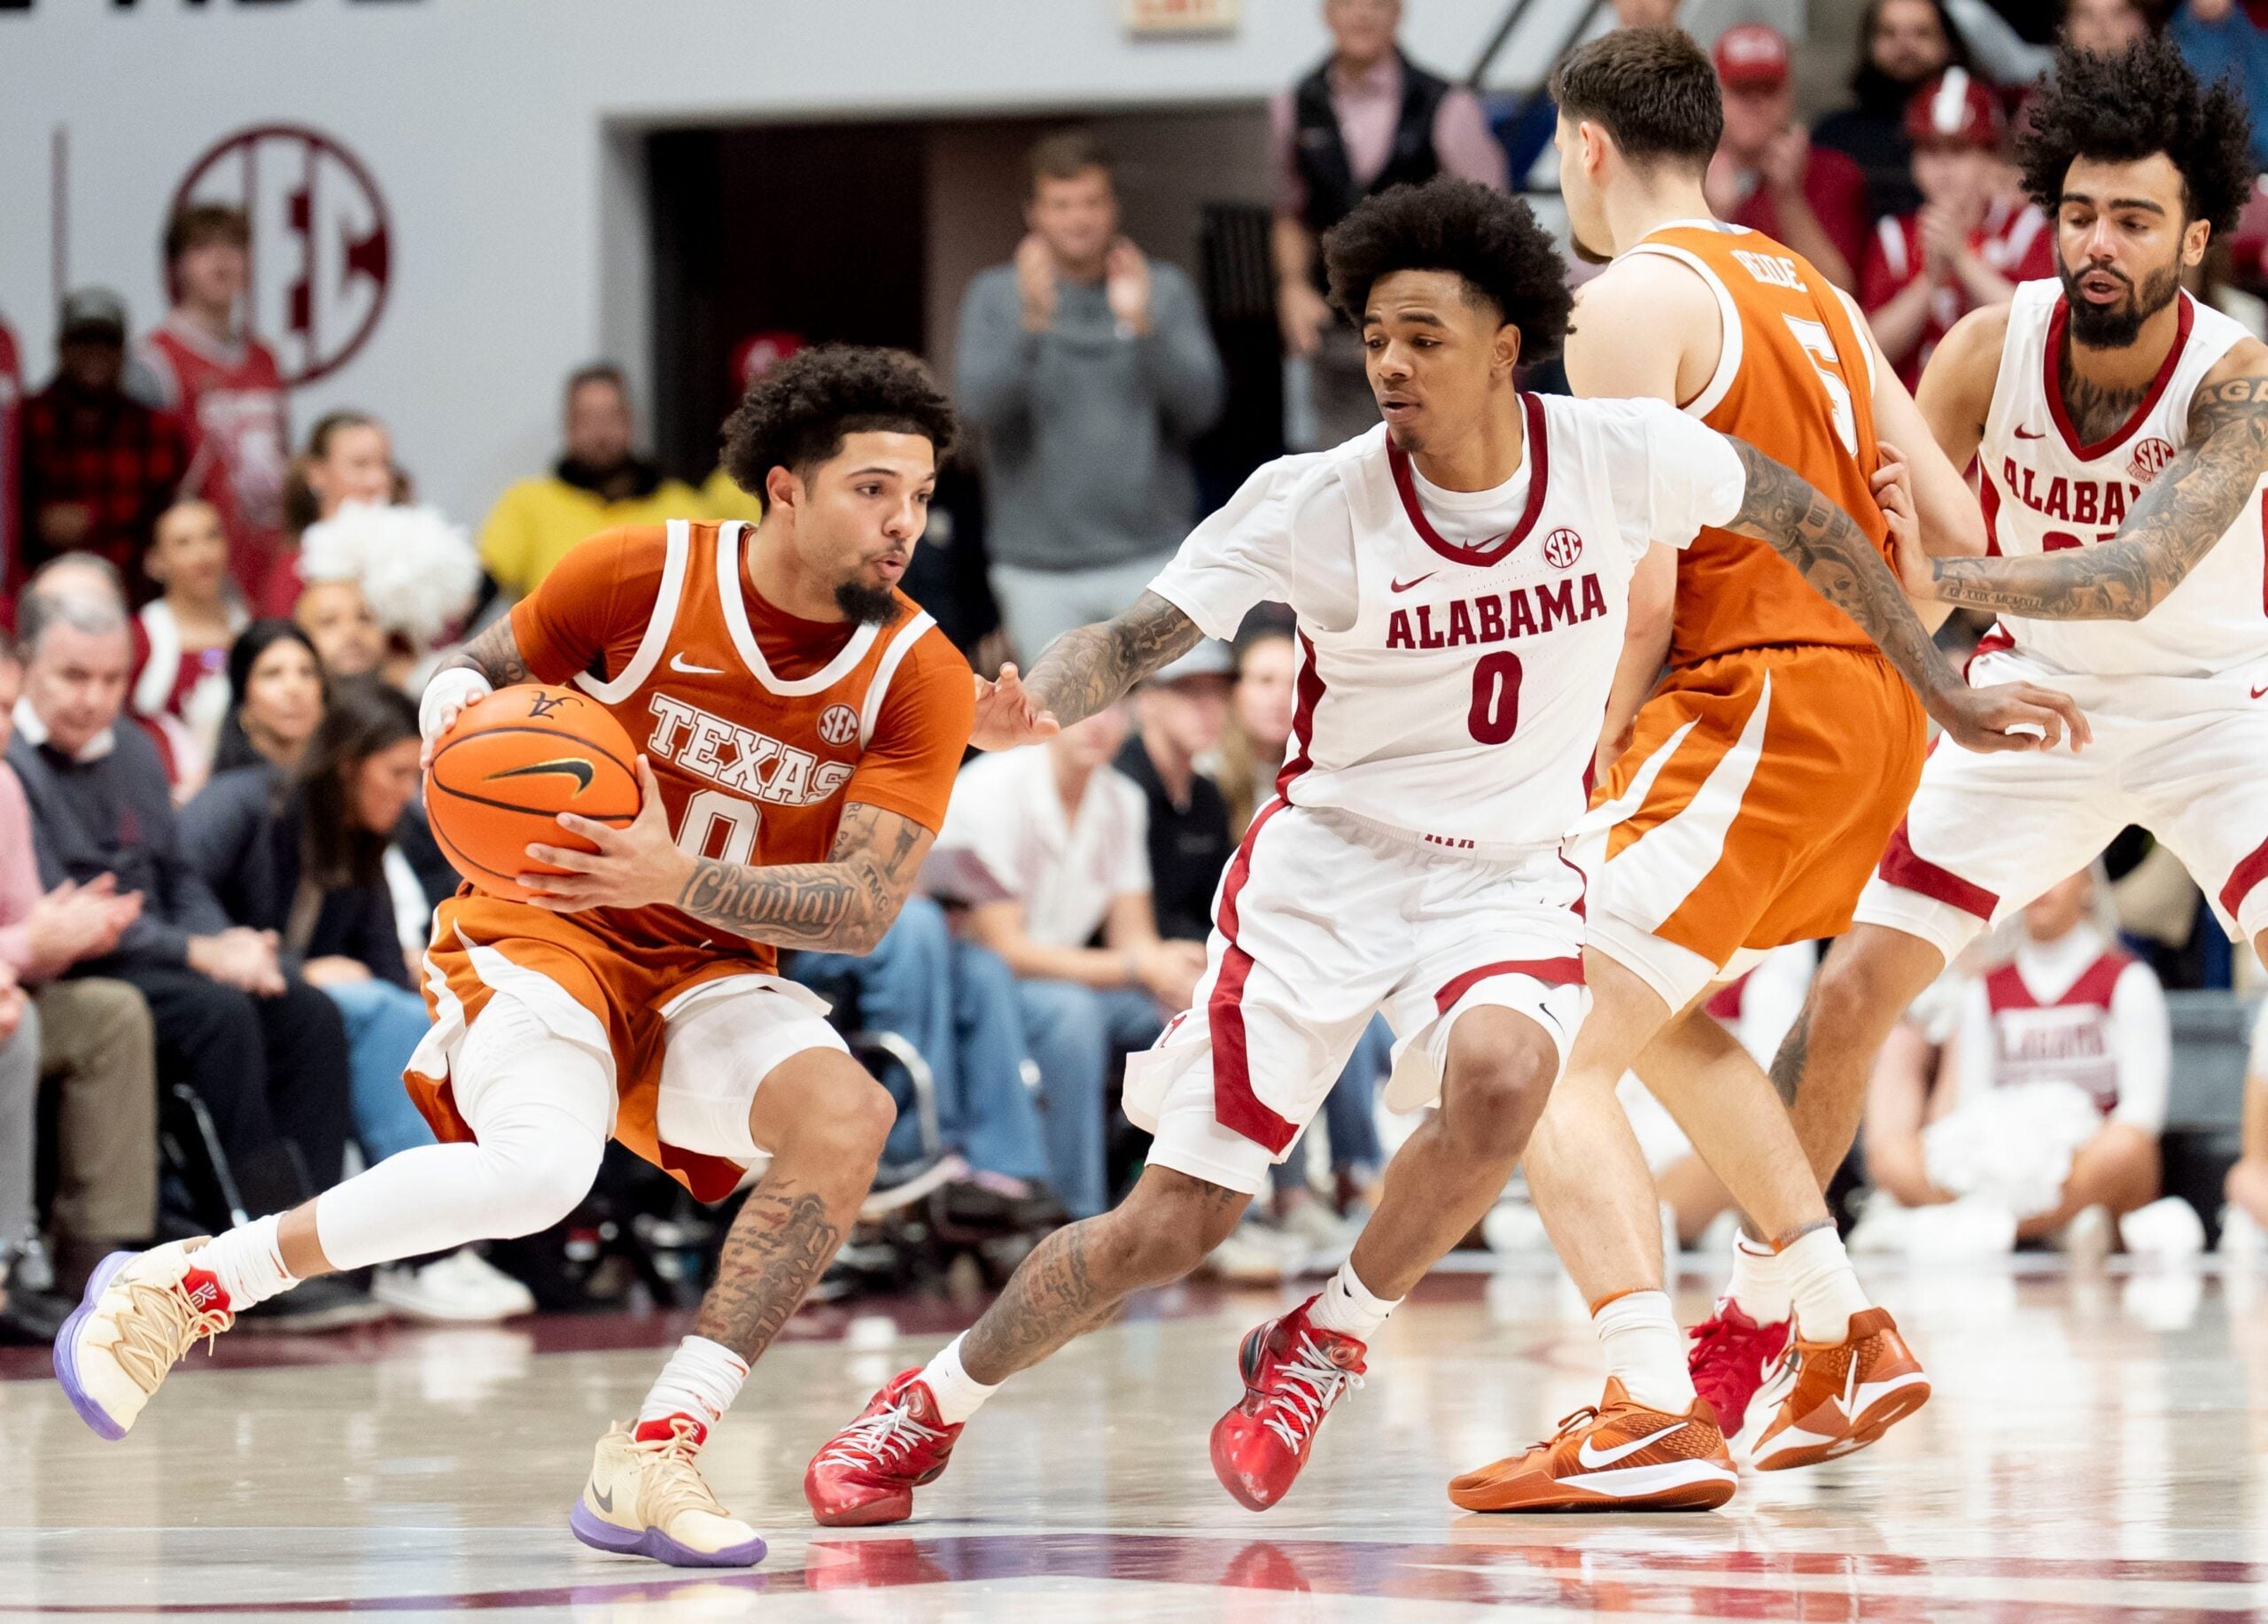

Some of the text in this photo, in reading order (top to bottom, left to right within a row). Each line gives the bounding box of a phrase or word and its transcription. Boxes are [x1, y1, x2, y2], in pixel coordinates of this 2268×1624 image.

[221, 128, 391, 384] EC
[1781, 311, 1859, 460] 5
[2004, 455, 2140, 525] ALABA
[1545, 530, 1581, 567] SEC
[1386, 573, 1608, 649] ALABAMA
[819, 705, 859, 745] SEC
[1467, 650, 1523, 745] 0
[648, 691, 857, 807] TEXAS
[676, 789, 762, 866] 0
